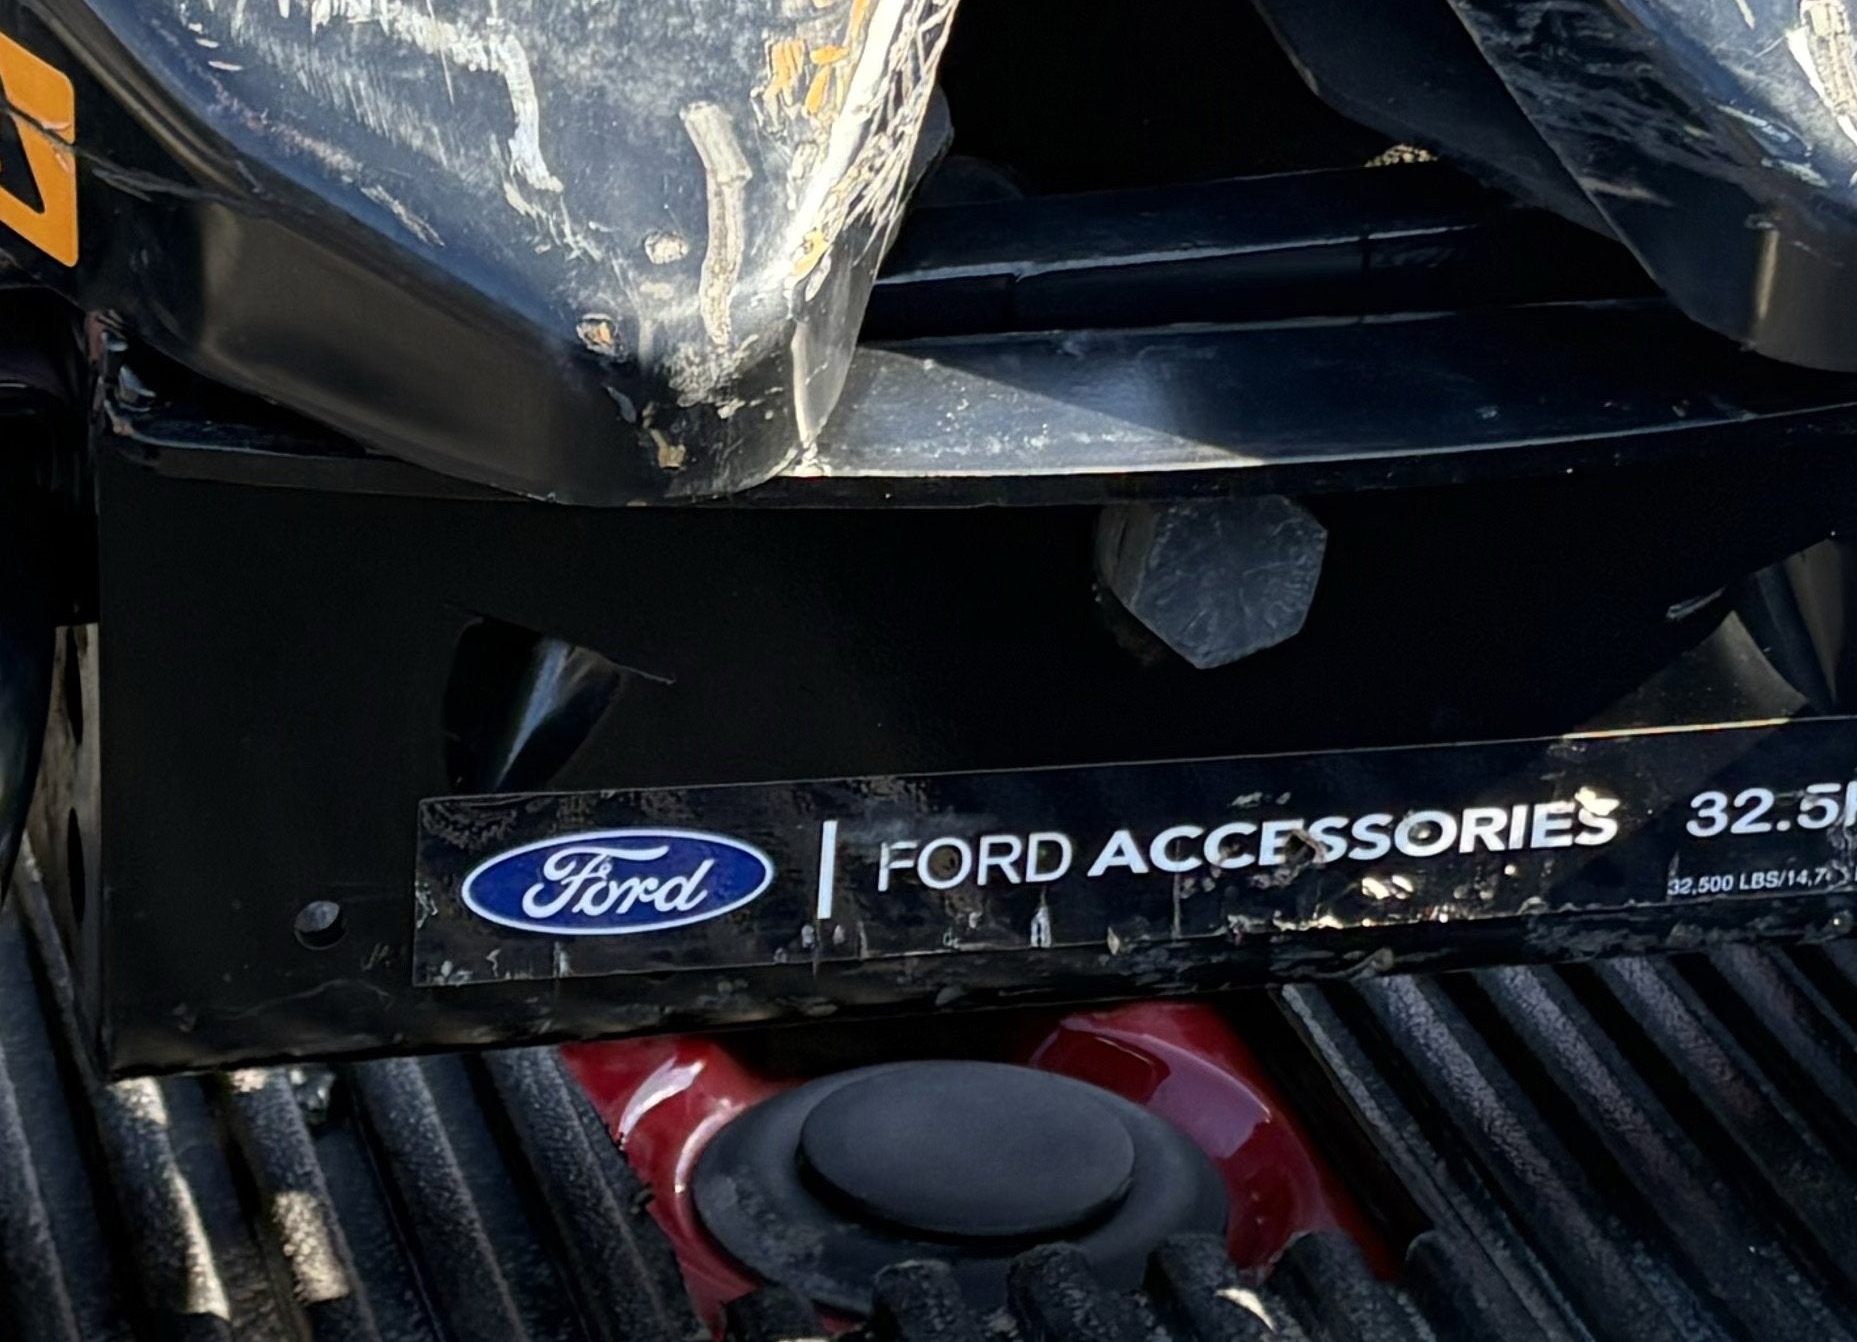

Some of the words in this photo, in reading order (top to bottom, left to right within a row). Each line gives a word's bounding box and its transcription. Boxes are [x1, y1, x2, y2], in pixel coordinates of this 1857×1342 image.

[521, 844, 716, 919] Ford
[875, 837, 1074, 893] FORD
[1085, 801, 1620, 878] ACCESSORIES
[1667, 874, 1735, 896] 32,500
